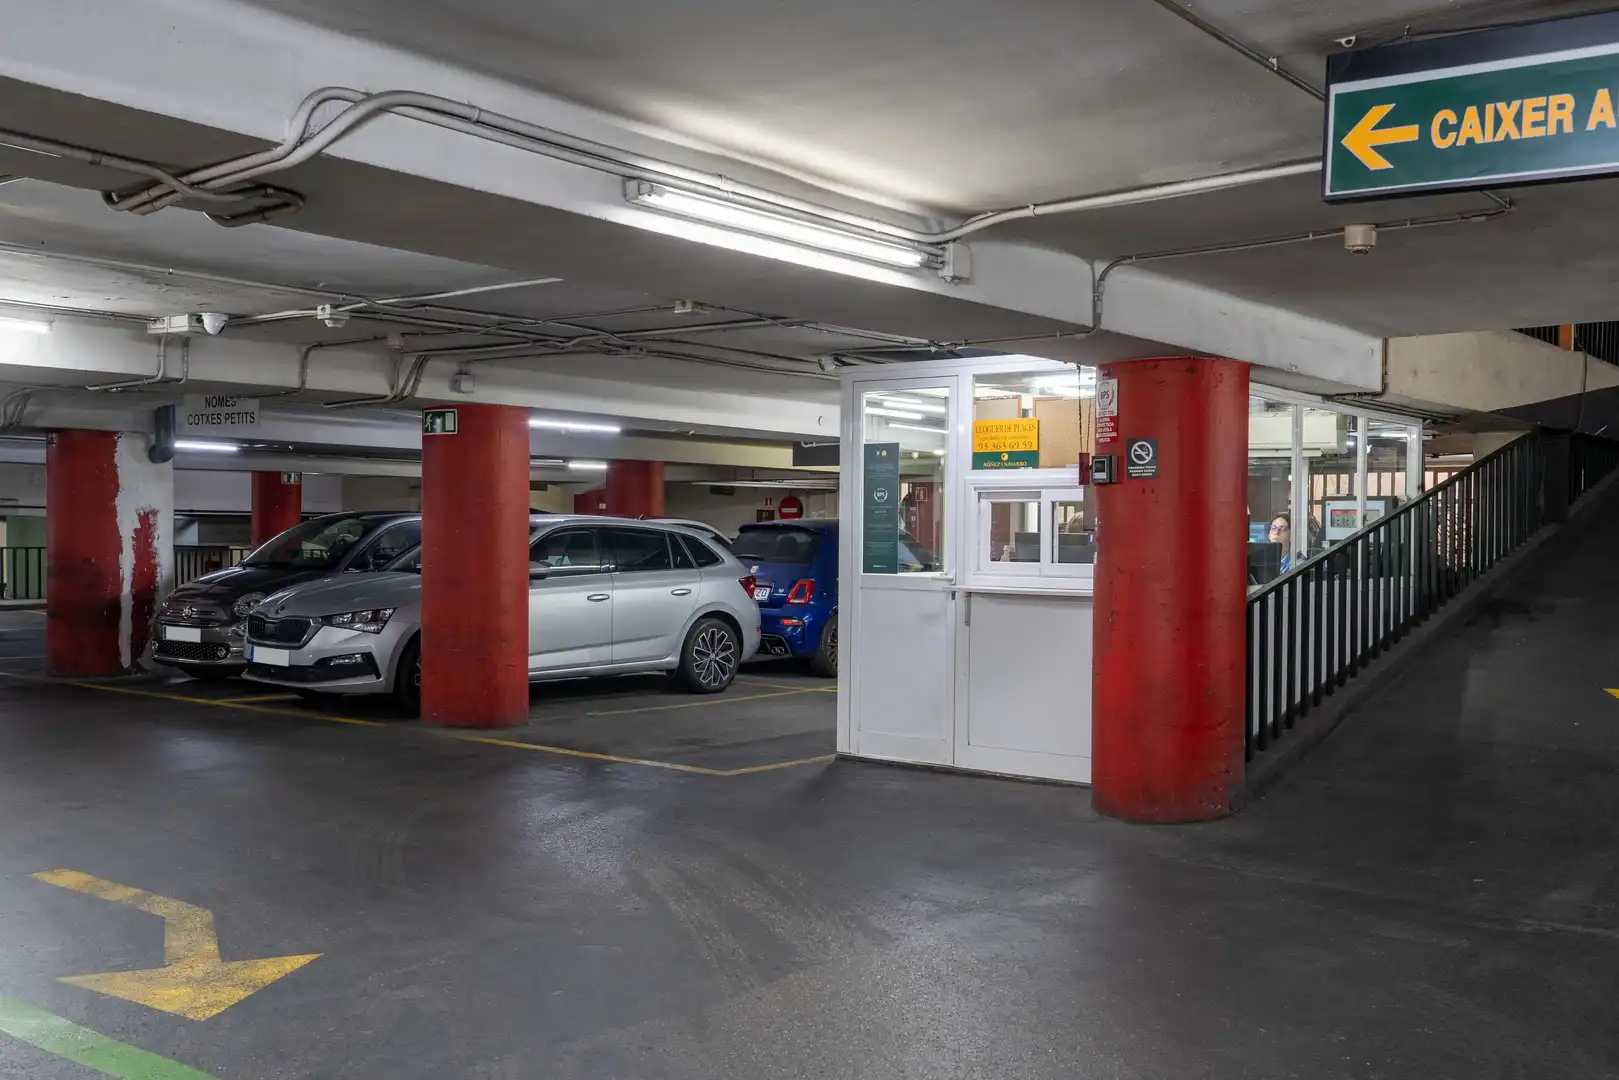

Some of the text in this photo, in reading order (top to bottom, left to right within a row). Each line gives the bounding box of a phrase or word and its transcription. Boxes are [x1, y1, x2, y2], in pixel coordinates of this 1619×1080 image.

[1431, 93, 1576, 149] CAIXER
[187, 411, 256, 426] COTXES PETITS
[975, 423, 1037, 434] LLOGUER DE PLACES
[977, 442, 989, 451] 93
[1008, 440, 1020, 450] 69
[1022, 440, 1033, 449] 59
